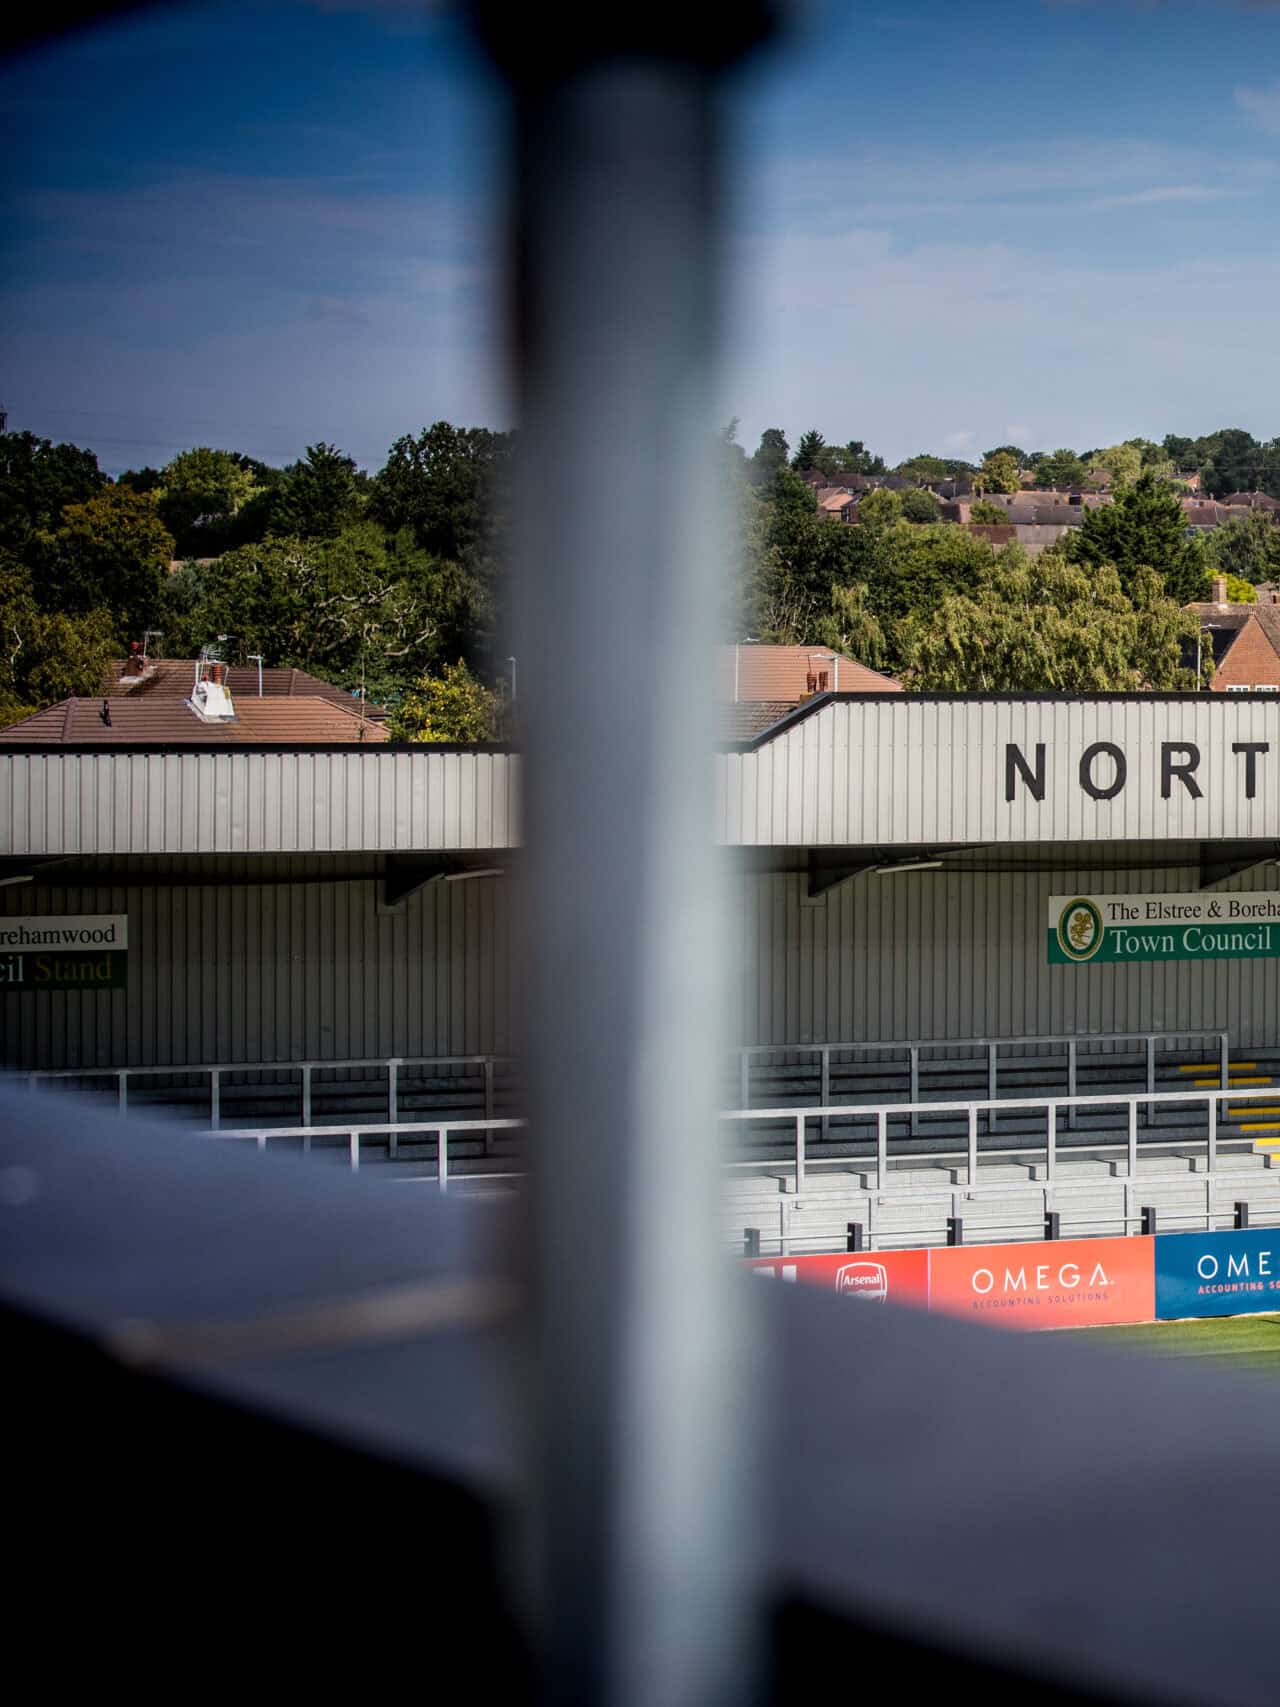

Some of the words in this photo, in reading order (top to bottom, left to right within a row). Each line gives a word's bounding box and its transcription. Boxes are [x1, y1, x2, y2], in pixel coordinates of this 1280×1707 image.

[1107, 902, 1140, 921] The
[1145, 900, 1202, 920] Elstree
[1207, 899, 1223, 918] &
[1109, 929, 1175, 954] Town
[1182, 925, 1272, 952] Council
[34, 953, 113, 982] Stand
[843, 1274, 881, 1287] Arsenal
[971, 1263, 1110, 1294] OMEGA
[1198, 1280, 1264, 1295] ACCOUNTING
[1047, 1292, 1109, 1305] SOLUTIONS
